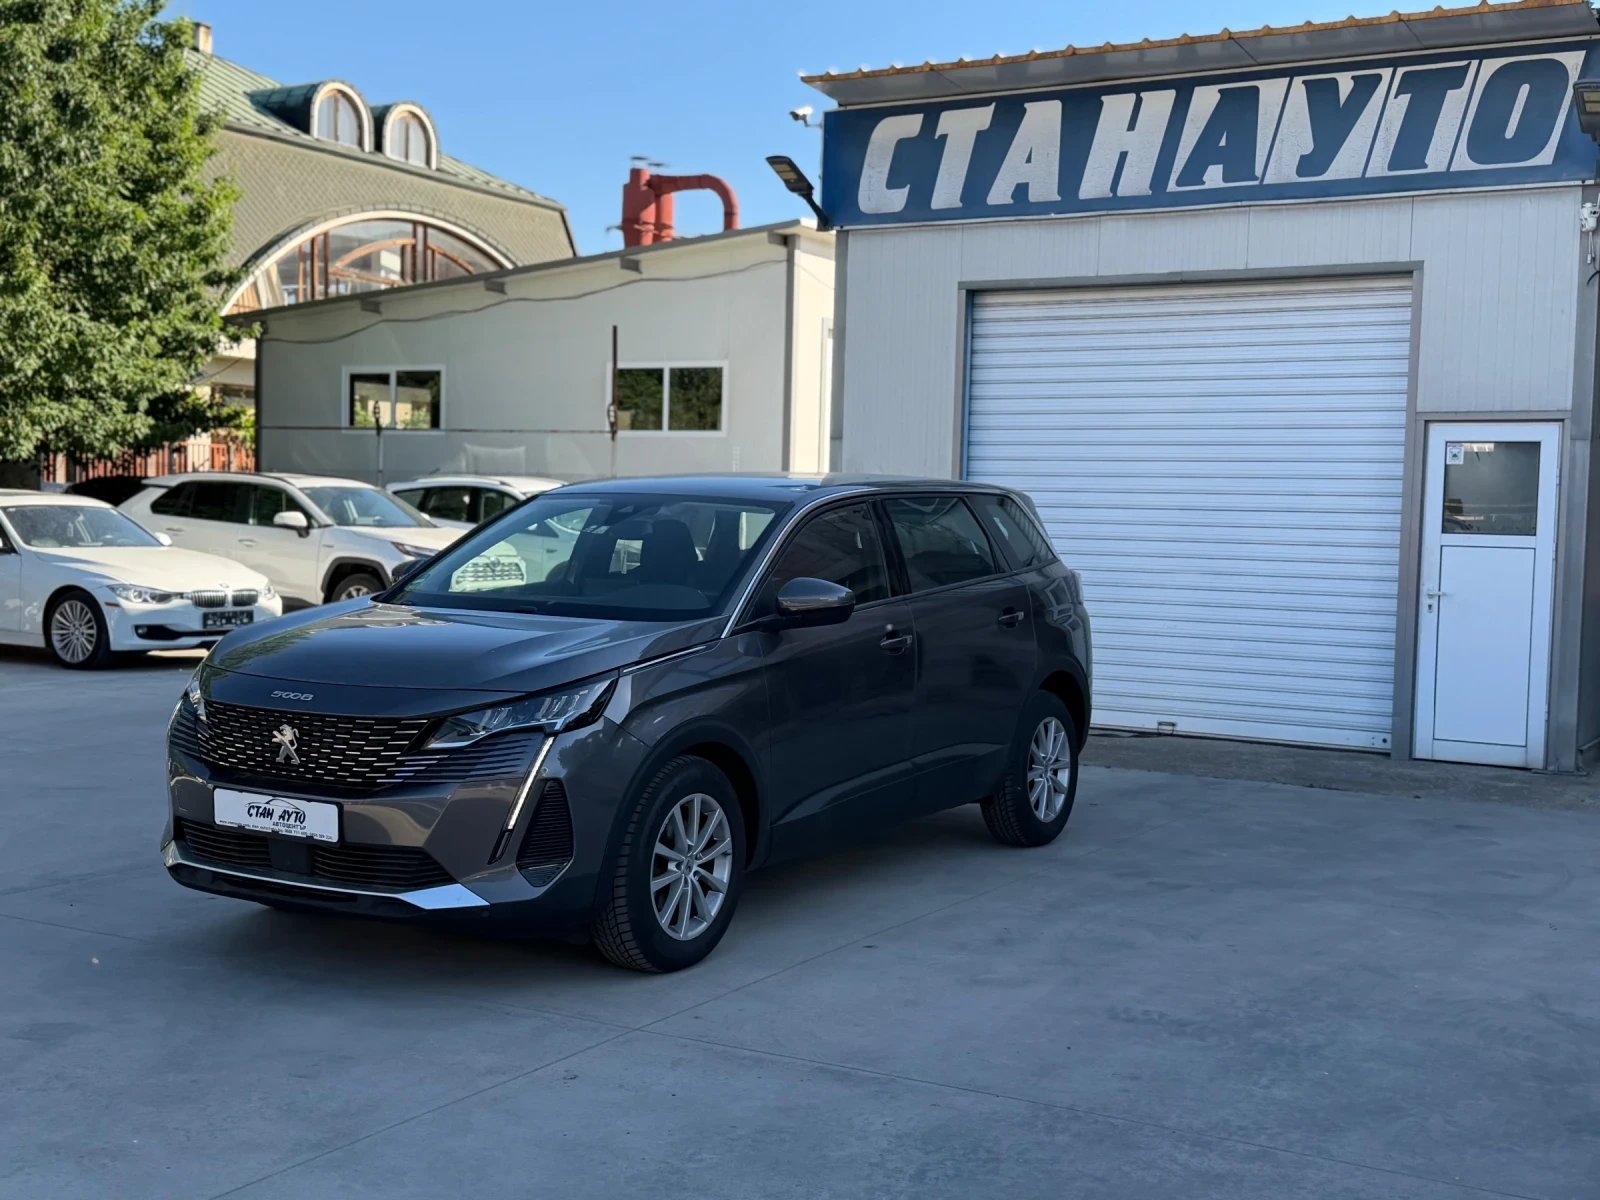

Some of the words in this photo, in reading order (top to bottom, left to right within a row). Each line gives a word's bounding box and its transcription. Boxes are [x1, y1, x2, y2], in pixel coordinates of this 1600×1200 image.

[270, 690, 314, 701] 5008
[247, 804, 275, 821] СТАН
[278, 808, 306, 825] АУТО
